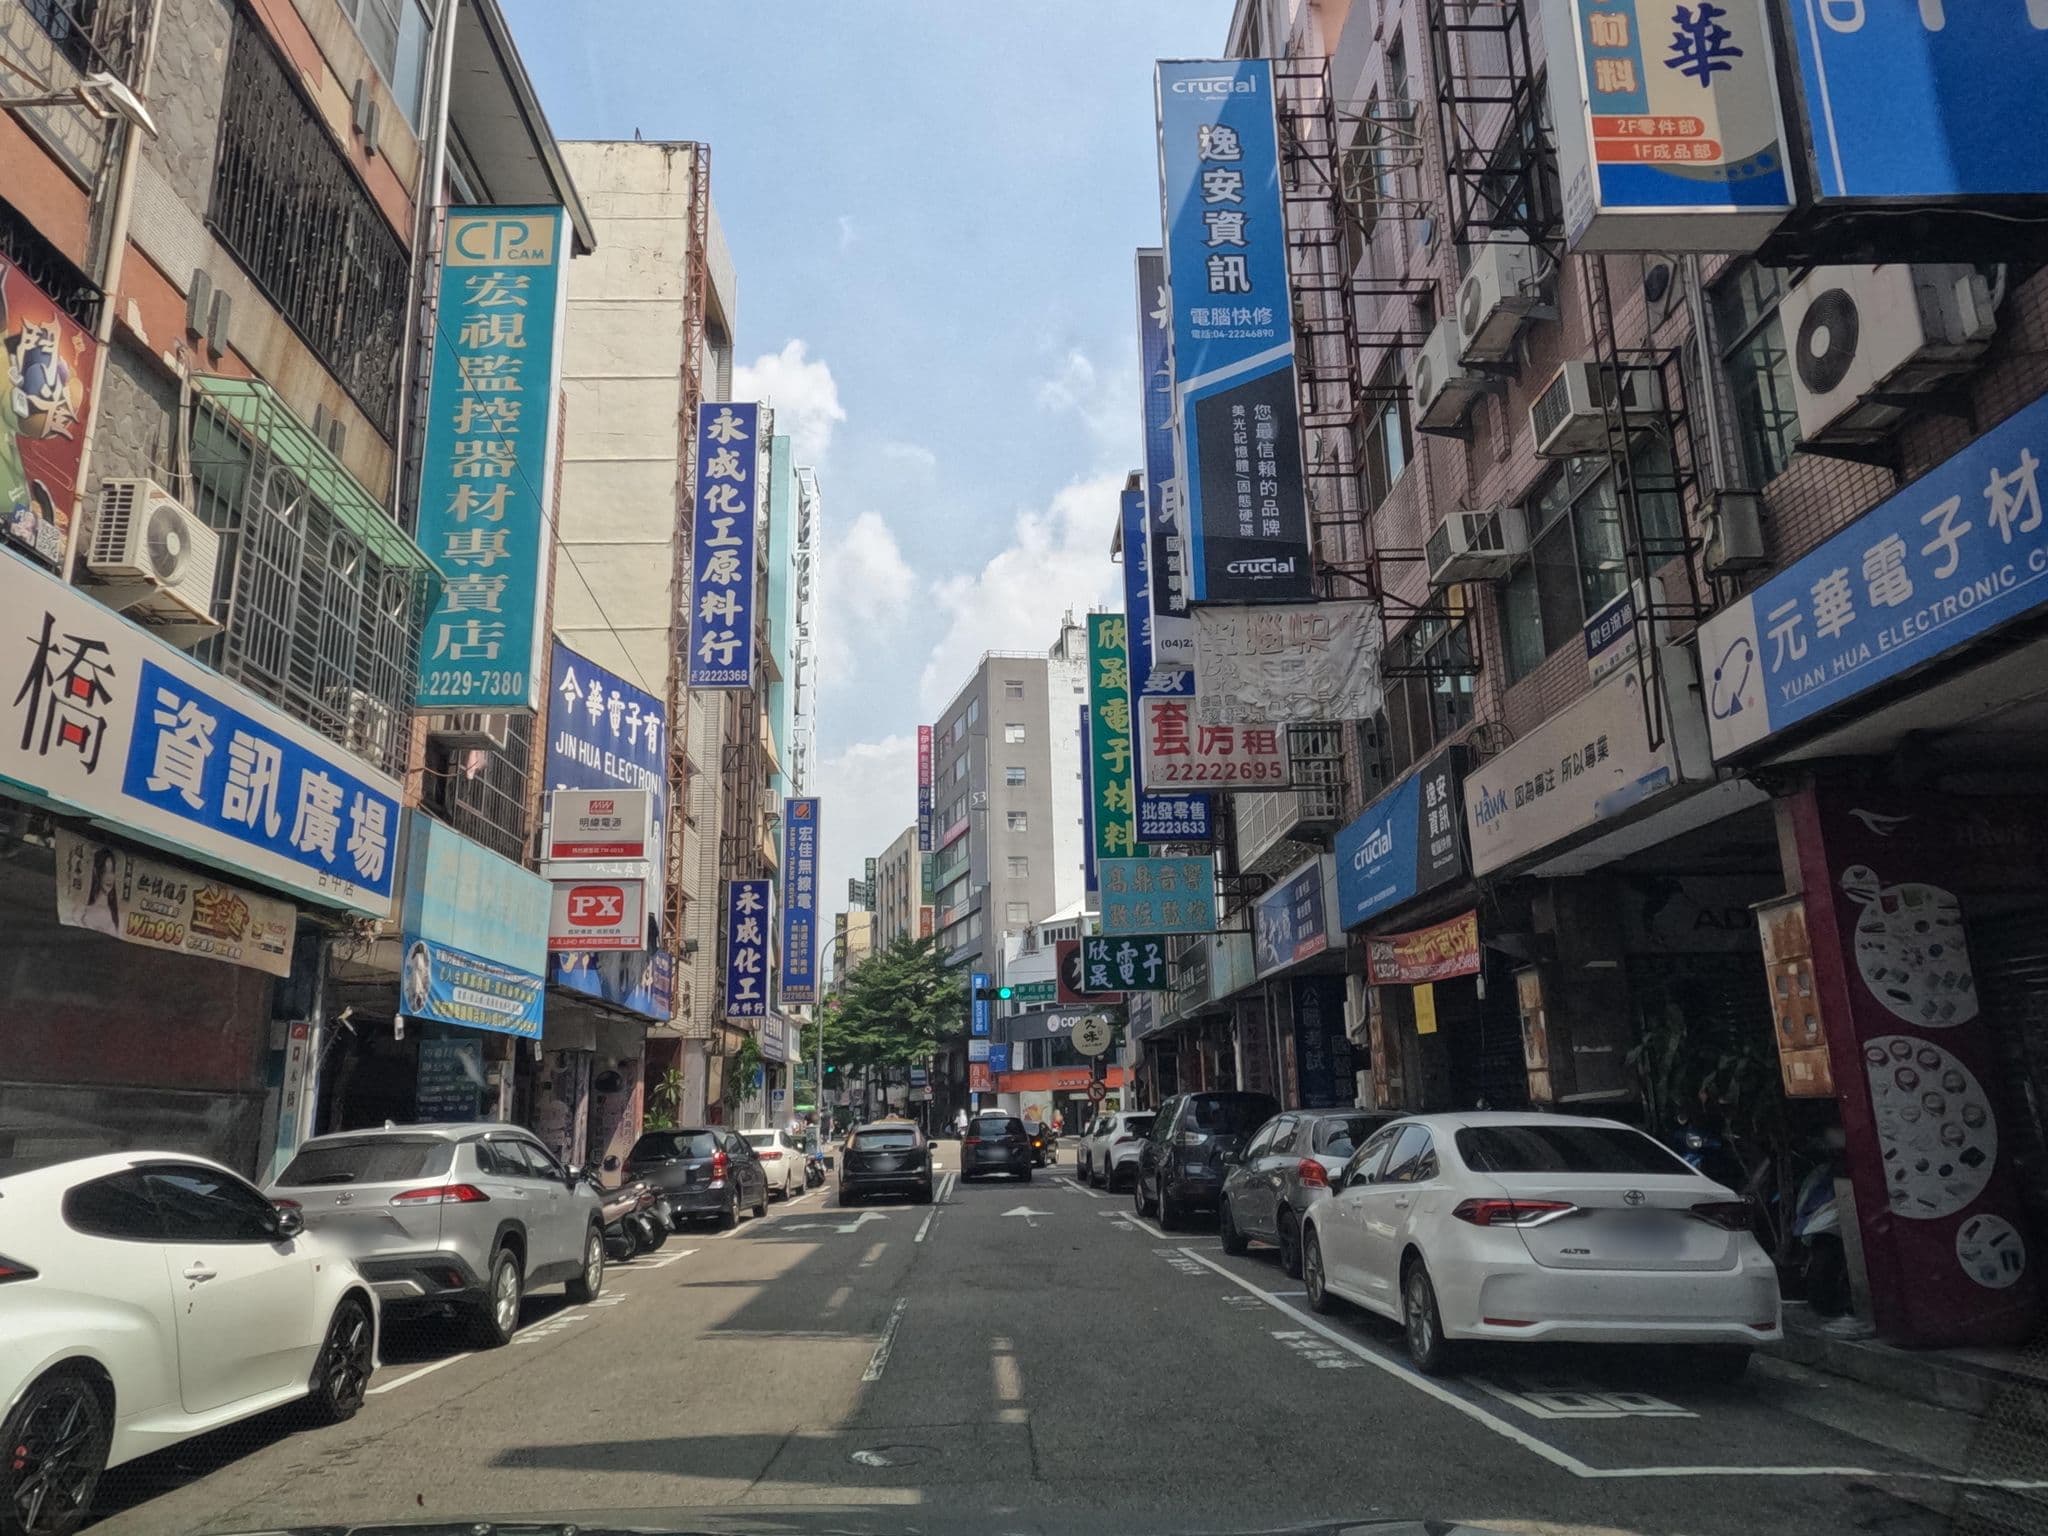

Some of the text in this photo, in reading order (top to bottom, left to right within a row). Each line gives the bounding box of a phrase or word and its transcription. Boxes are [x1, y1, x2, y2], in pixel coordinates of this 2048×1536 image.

[1663, 4, 1744, 88] 華
[1171, 74, 1257, 94] crucial
[1616, 118, 1698, 137] 2F零件部
[1633, 142, 1713, 160] 1F成品部
[1199, 125, 1250, 293] 逸安資訊
[508, 248, 545, 261] CAM
[1190, 307, 1273, 327] 電腦快修
[431, 271, 531, 661] 宏視監控器材專賣店
[1231, 404, 1254, 537] 美光記憶體/固態硬碟
[1253, 403, 1281, 537] 您最信賴的品牌
[697, 407, 750, 666] 永成化工原料行
[1226, 556, 1296, 575] crucial
[1766, 448, 2043, 674] 元華電子材
[1780, 544, 2048, 699] YUAN HUA ELECTRONIC C
[13, 610, 116, 775] 橋
[699, 669, 748, 682] 22223368
[558, 665, 665, 758] 今華電子有
[555, 731, 577, 760] JIN
[578, 739, 602, 771] HUA
[1561, 734, 1609, 783] 所以專業
[145, 686, 388, 882] 資訊廣場
[1165, 761, 1283, 782] 22222695
[1513, 767, 1556, 810] 因為專注
[972, 791, 987, 805] 53
[1141, 801, 1206, 821] 批發零售
[1141, 821, 1206, 835] 22223633
[1353, 818, 1393, 871] crucial
[571, 895, 621, 918] PX
[125, 911, 186, 946] Win999
[733, 884, 764, 1001] 永成化工
[728, 1001, 765, 1015] 原料行
[1560, 1247, 1591, 1255] ALTIS
